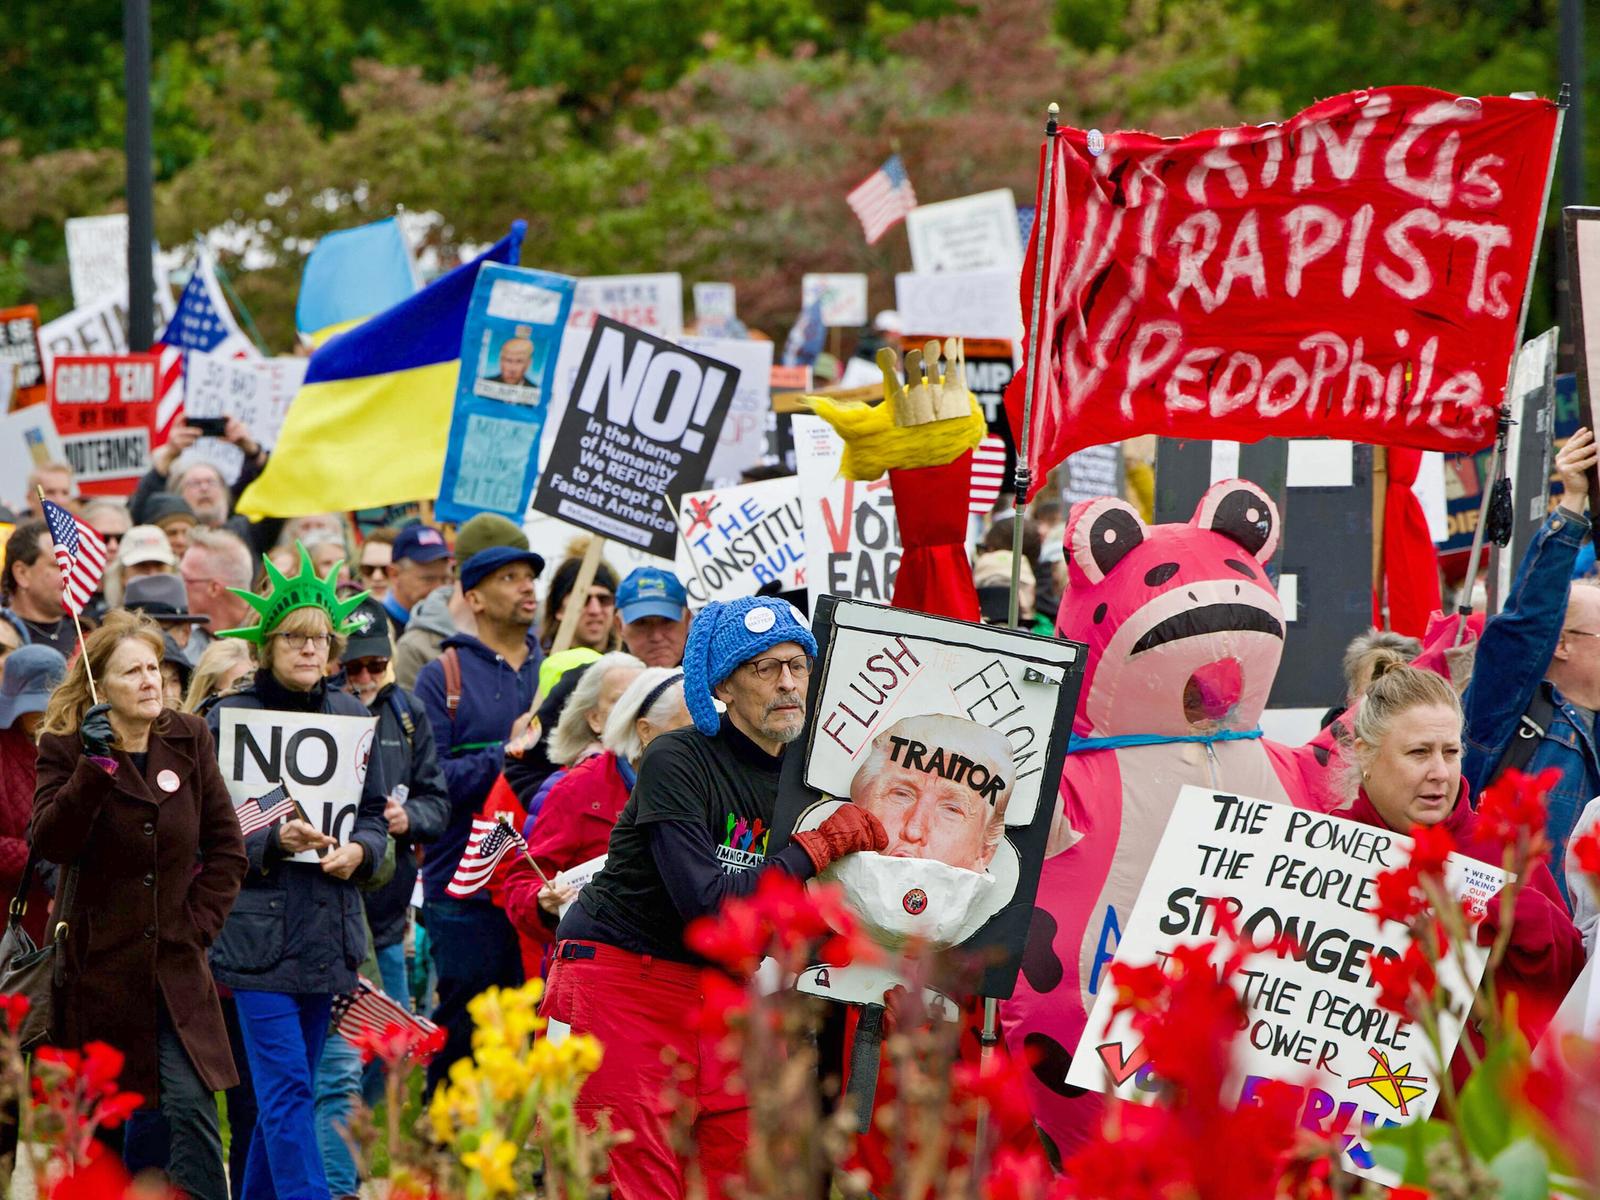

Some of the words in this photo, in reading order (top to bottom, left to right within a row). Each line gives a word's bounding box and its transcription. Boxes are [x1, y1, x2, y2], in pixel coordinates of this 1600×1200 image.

[577, 326, 727, 453] NO!
[580, 435, 599, 450] of
[599, 439, 678, 485] Humanity
[586, 416, 602, 435] In
[605, 425, 631, 446] the
[632, 435, 682, 465] Name
[550, 472, 605, 508] Fascist
[605, 497, 676, 533] America
[572, 465, 590, 483] to
[591, 473, 650, 507] Accept
[651, 499, 664, 513] a
[580, 449, 606, 471] We
[606, 460, 668, 496] REFUSE
[694, 497, 765, 557] THE
[822, 636, 921, 755] FLUSH
[233, 723, 338, 786] NO
[890, 735, 1006, 807] TRAITOR
[1213, 794, 1273, 835] THE
[1285, 811, 1392, 868] POWER
[1198, 844, 1254, 880] THE
[1265, 854, 1379, 913] PEOPLE
[1465, 876, 1496, 892] TAKING
[1469, 887, 1487, 898] OUR
[1237, 968, 1302, 1015] THE
[1307, 989, 1411, 1051] PEOPLE
[1239, 1012, 1342, 1077] OWER
